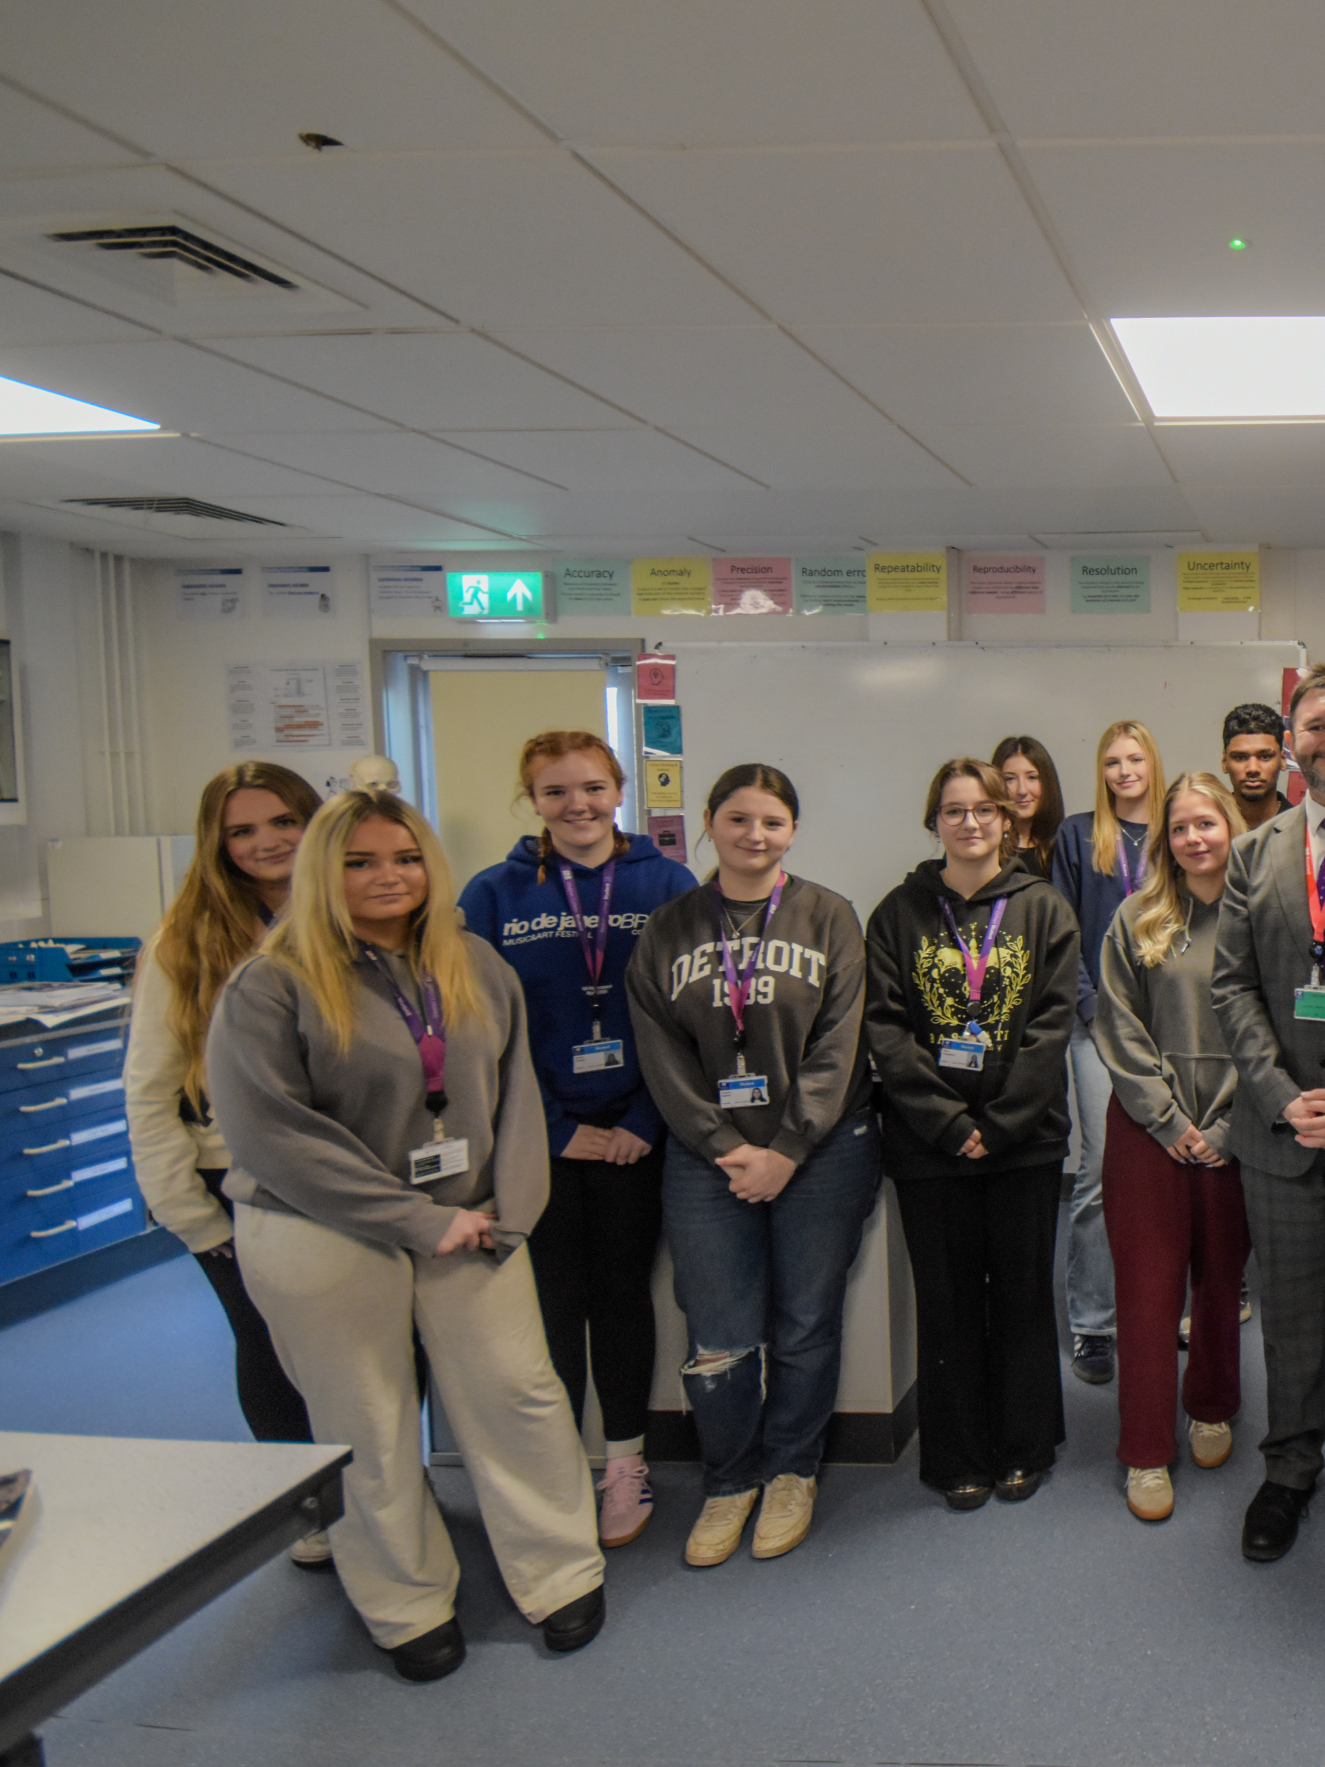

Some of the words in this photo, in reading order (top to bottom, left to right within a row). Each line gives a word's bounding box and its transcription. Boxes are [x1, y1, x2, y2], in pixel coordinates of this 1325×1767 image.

[730, 565, 773, 575] Precision
[801, 566, 843, 577] Random
[874, 563, 942, 575] Repeatability
[972, 565, 1037, 575] Reproducibility
[1081, 565, 1138, 576] Resolution
[1187, 560, 1251, 572] Uncertainty
[563, 567, 615, 580] Accuracy
[650, 567, 692, 578] Anomaly
[502, 918, 530, 936] rio
[531, 912, 558, 931] de
[670, 936, 826, 1002] DETROIT
